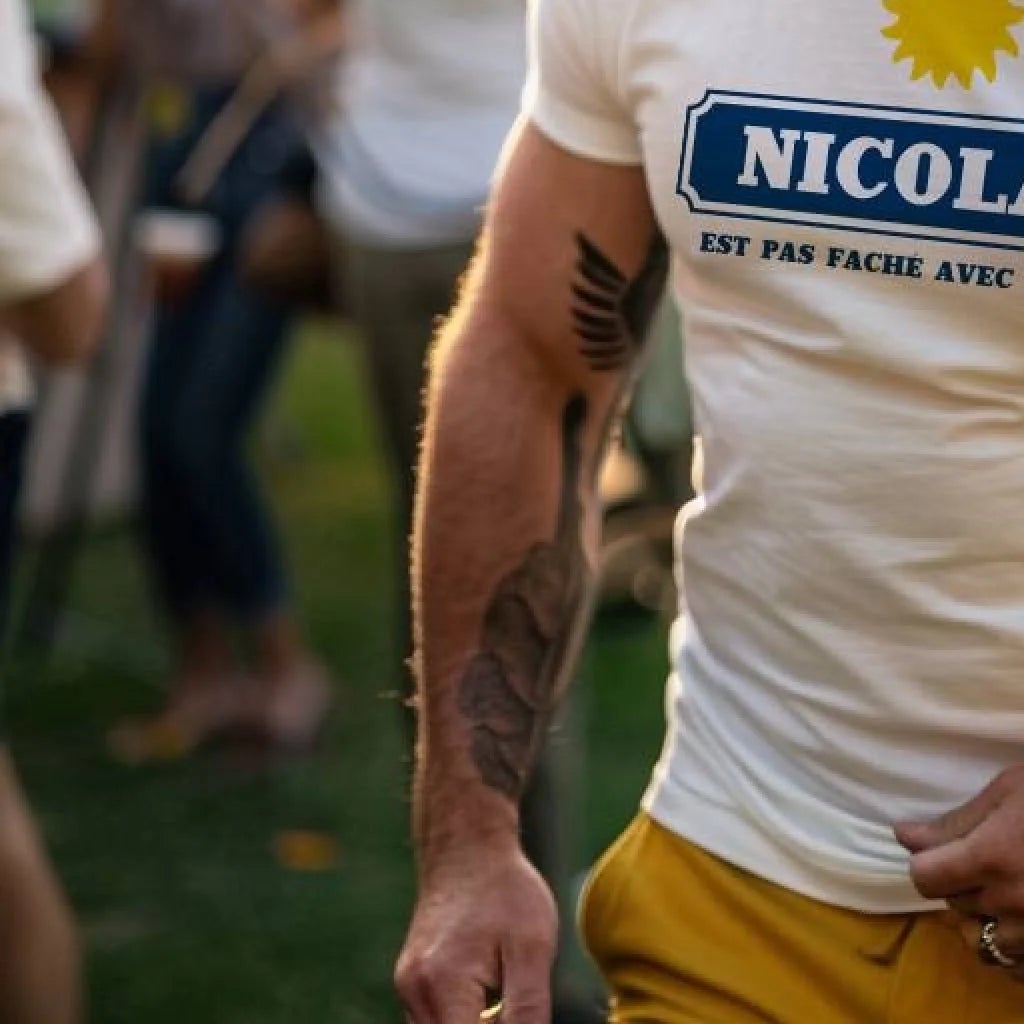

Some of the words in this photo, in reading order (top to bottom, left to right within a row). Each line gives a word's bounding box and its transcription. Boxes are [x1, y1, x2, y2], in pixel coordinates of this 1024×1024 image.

[700, 231, 751, 257] EST
[760, 239, 815, 264] PAS
[934, 261, 1015, 289] AVEC
